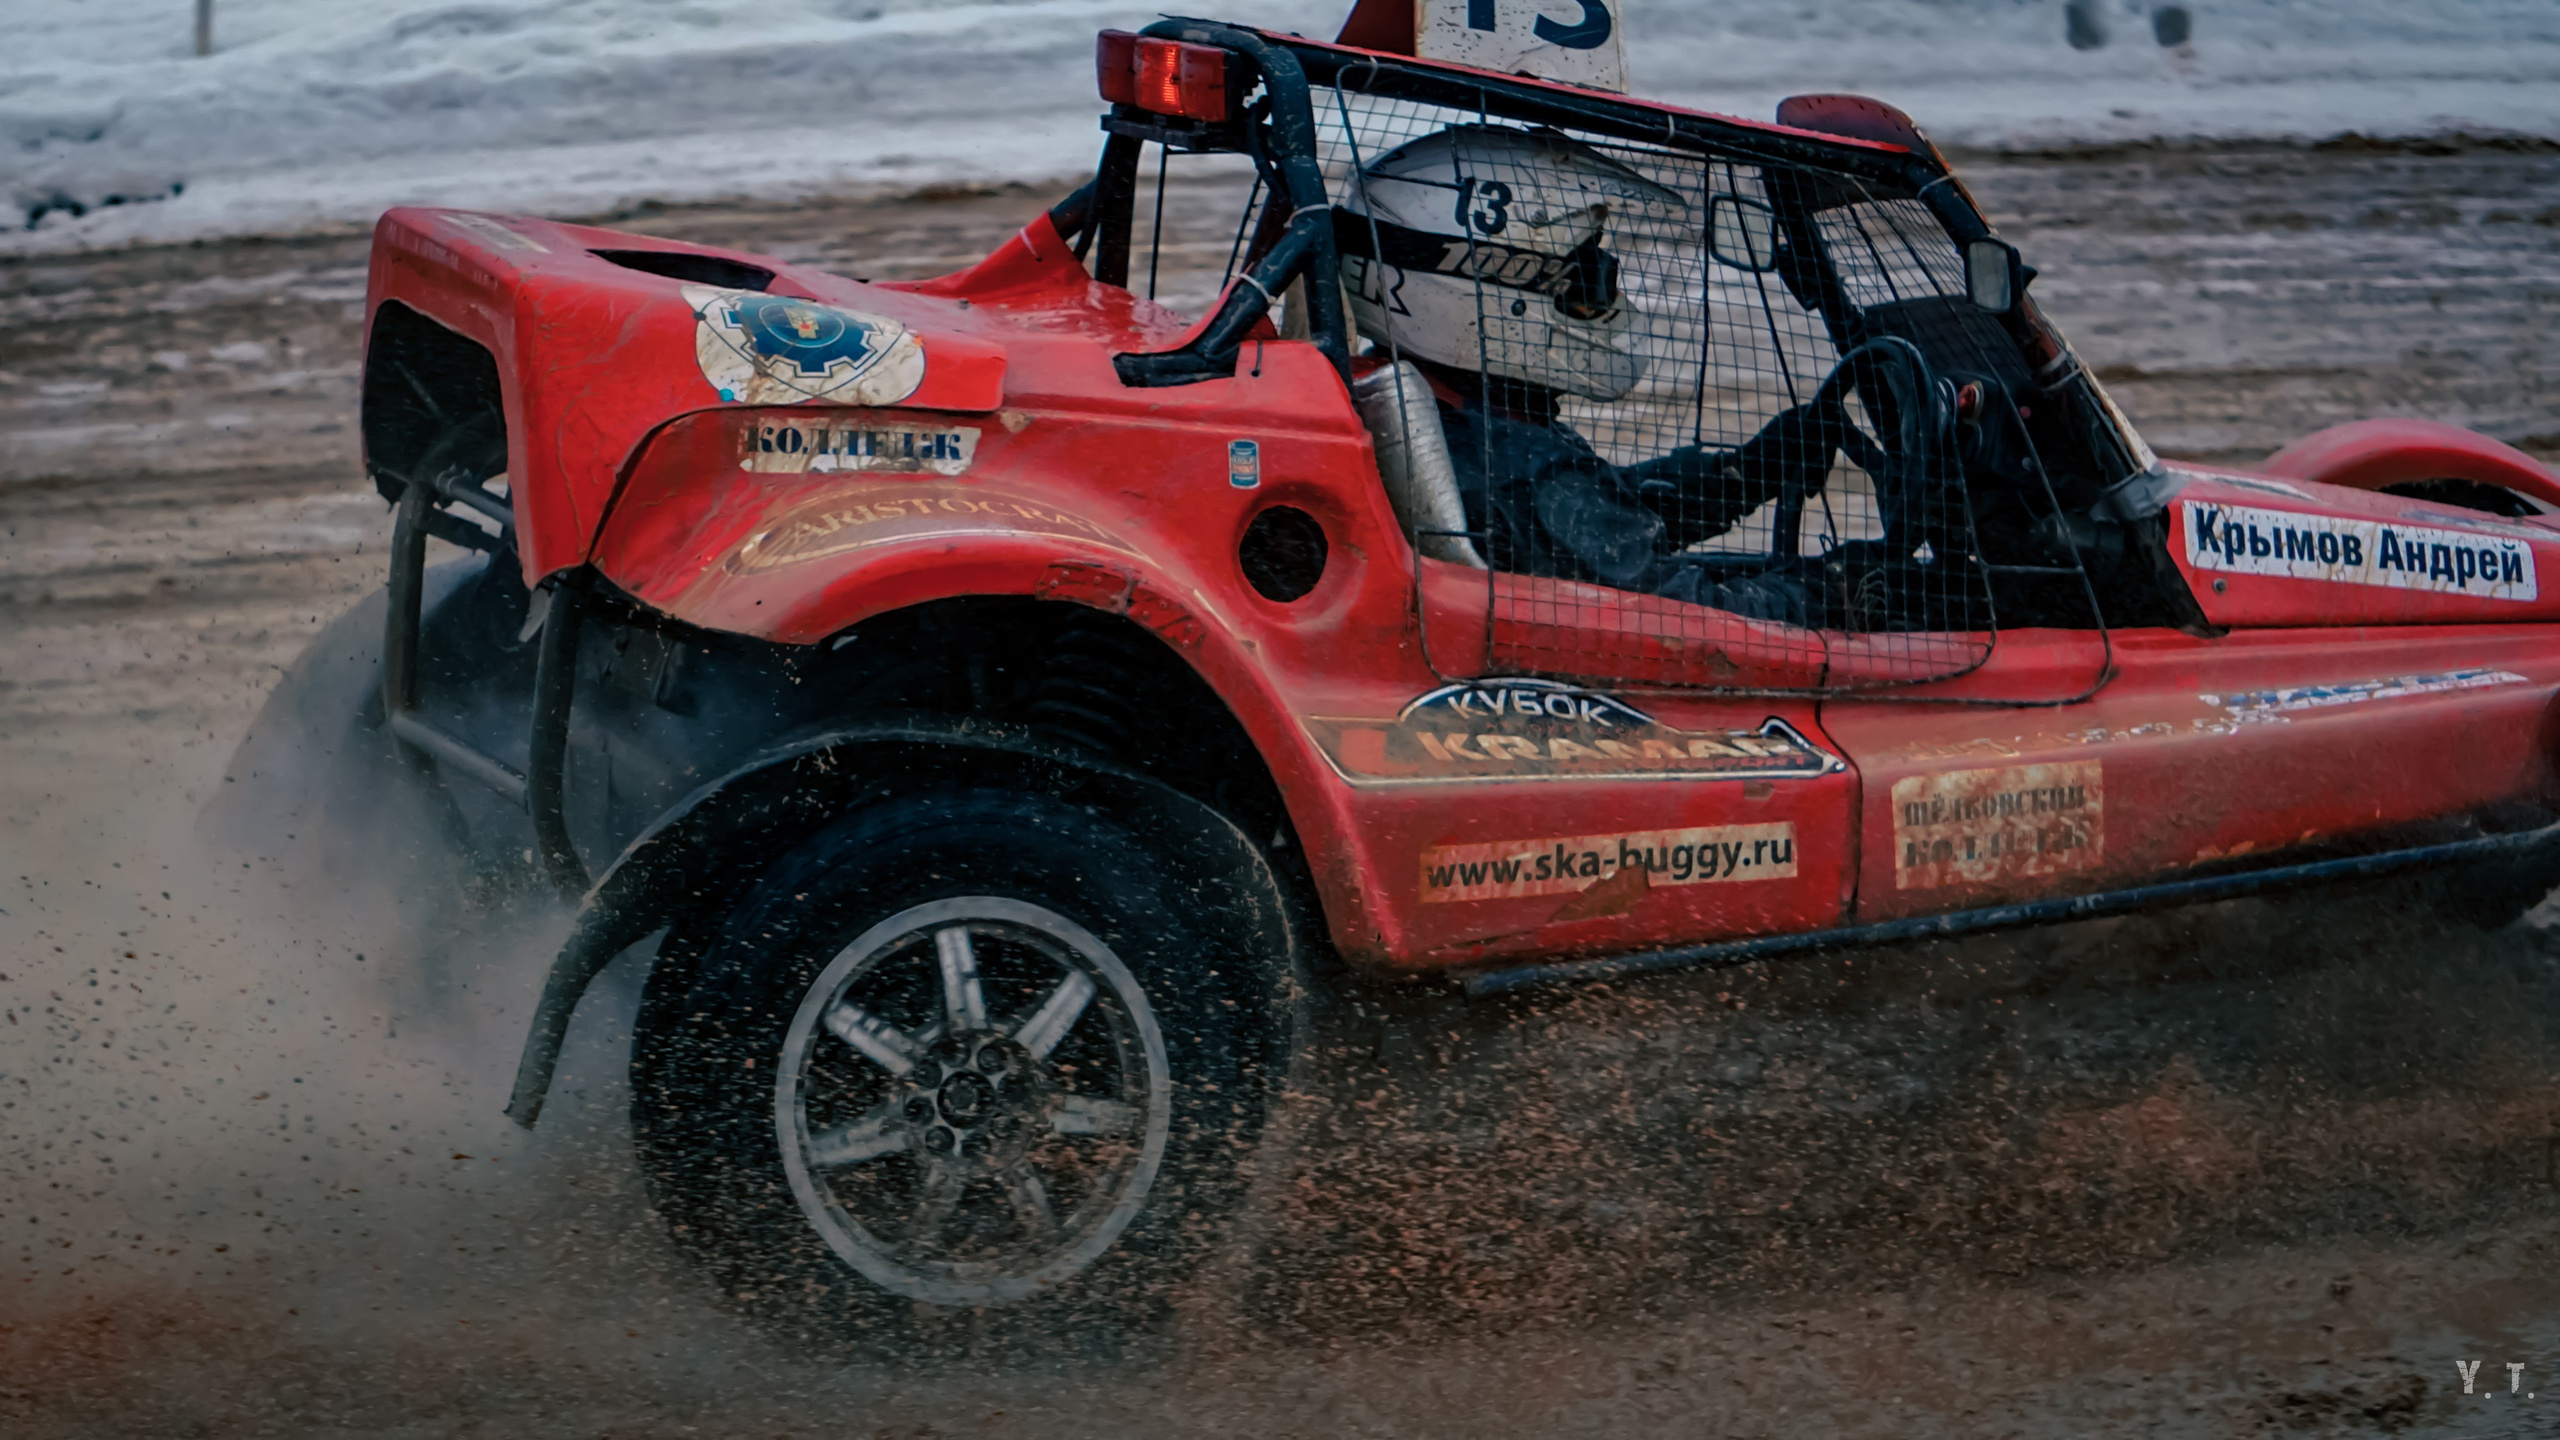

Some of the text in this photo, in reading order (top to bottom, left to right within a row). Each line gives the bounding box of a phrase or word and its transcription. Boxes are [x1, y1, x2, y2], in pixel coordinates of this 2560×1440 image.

[1455, 177, 1513, 235] 13
[2195, 507, 2524, 588] Крымов Андрей
[1447, 689, 1613, 727] КУБОК
[1428, 837, 1792, 888] www.ska-buggy.ru
